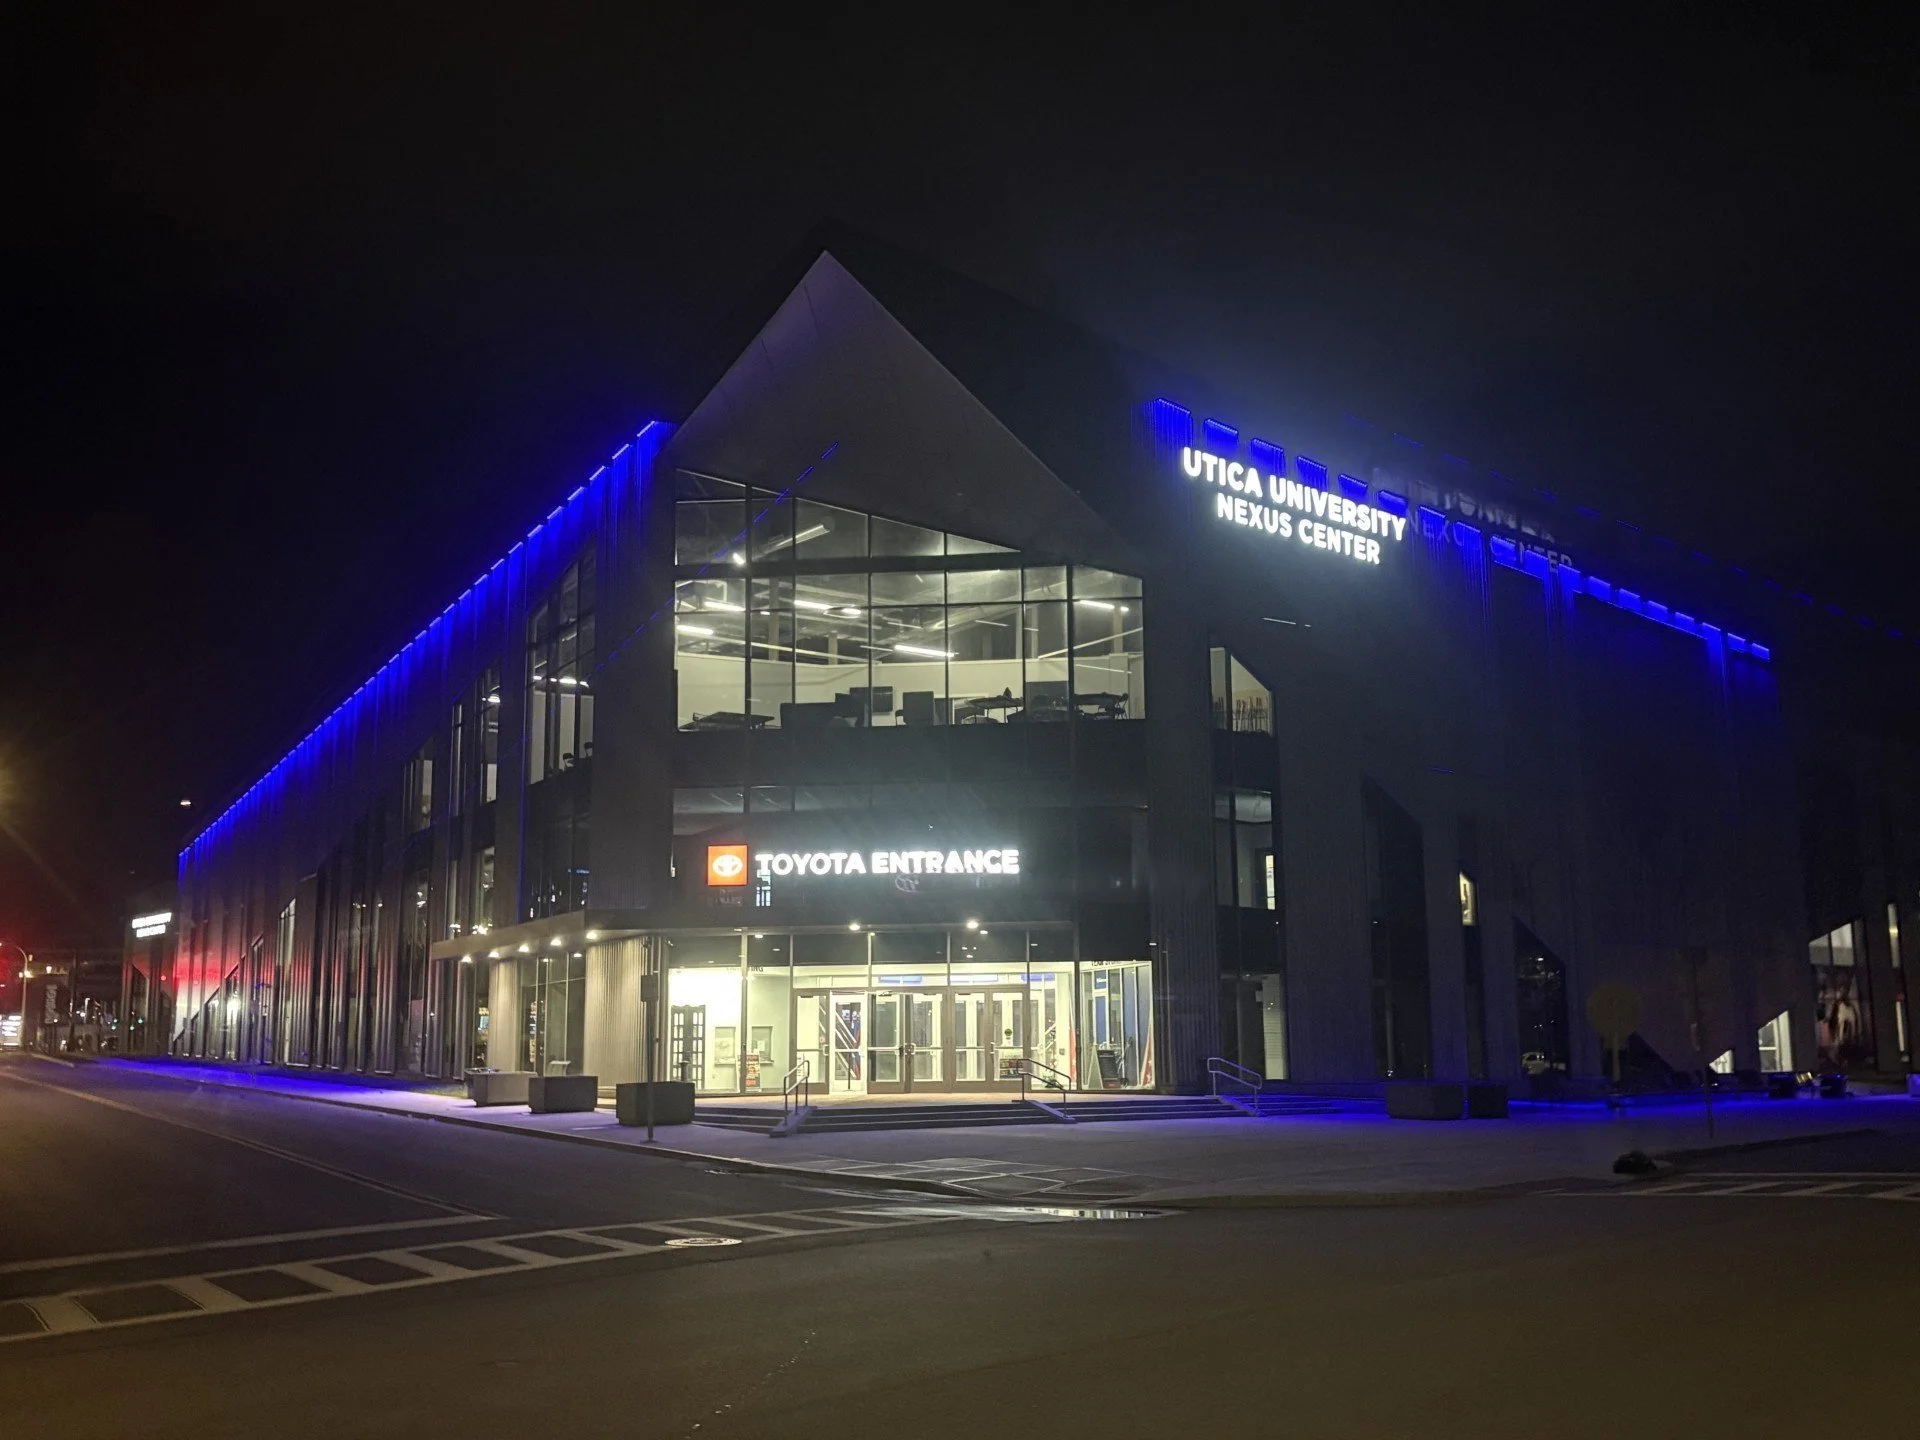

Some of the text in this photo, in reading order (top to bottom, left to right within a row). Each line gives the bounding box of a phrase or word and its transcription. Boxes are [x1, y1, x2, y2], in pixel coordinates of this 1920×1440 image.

[1183, 446, 1263, 498] UTICA
[1269, 475, 1407, 541] UNIVERSITY
[1216, 493, 1380, 564] NEXUS CENTER
[755, 849, 1020, 875] TOYOTA ENTRANCE
